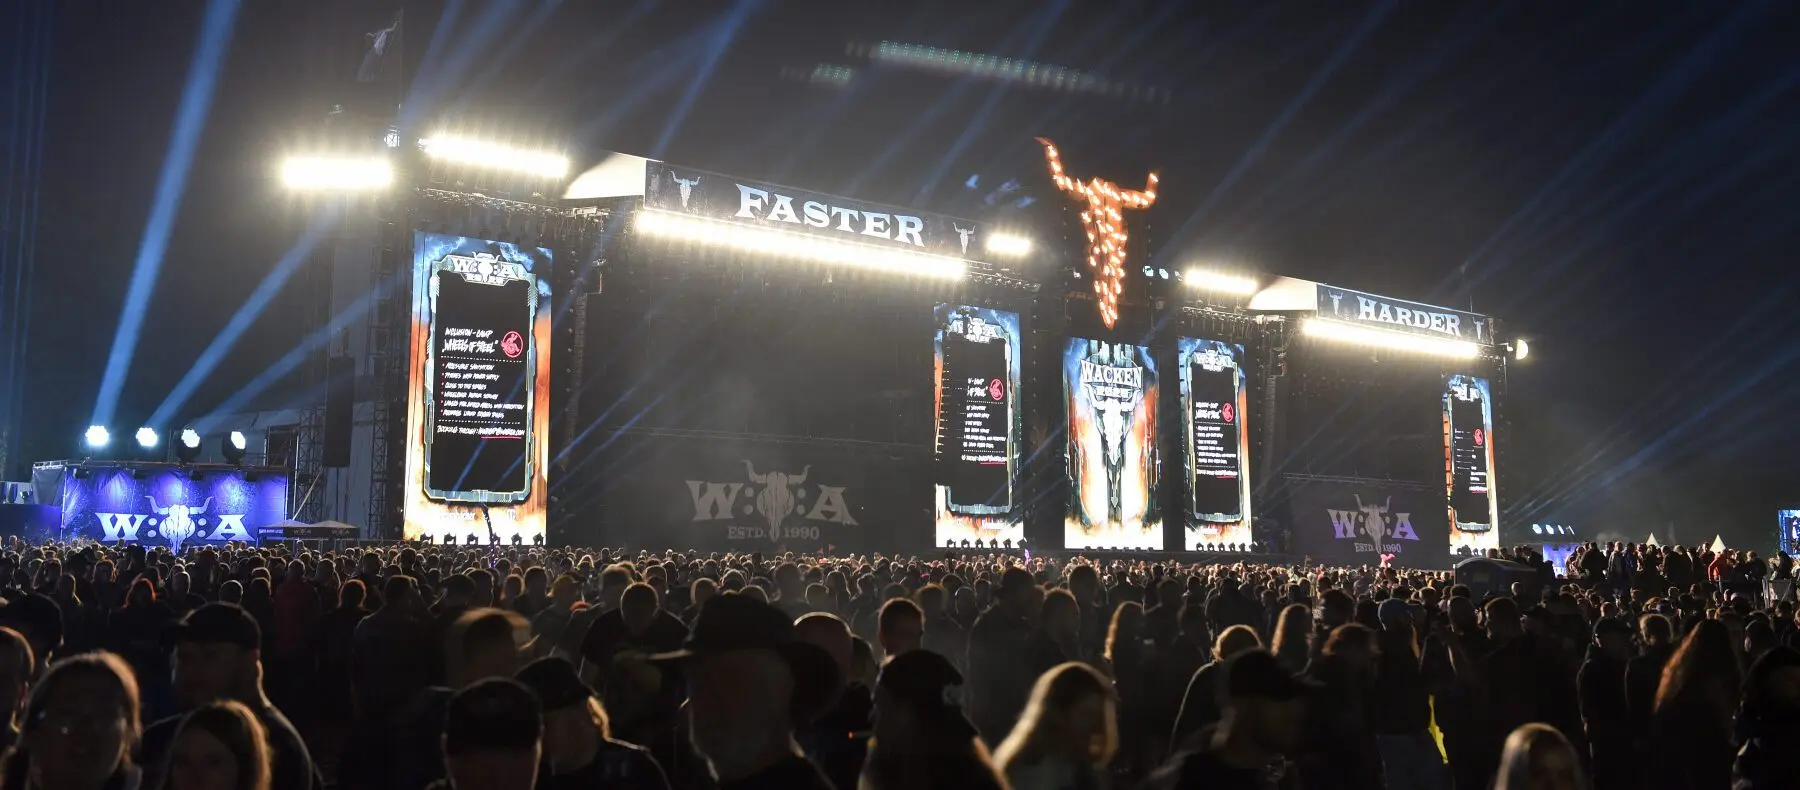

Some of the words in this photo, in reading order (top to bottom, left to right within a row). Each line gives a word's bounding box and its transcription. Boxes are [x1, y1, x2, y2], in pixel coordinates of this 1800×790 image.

[735, 183, 926, 248] FASTER
[1356, 295, 1462, 337] HARDER
[1081, 360, 1143, 389] WACKEN
[727, 525, 767, 540] ESTD.
[784, 526, 820, 540] 1990
[1354, 542, 1375, 553] ESTD.
[1383, 543, 1402, 553] 1990
